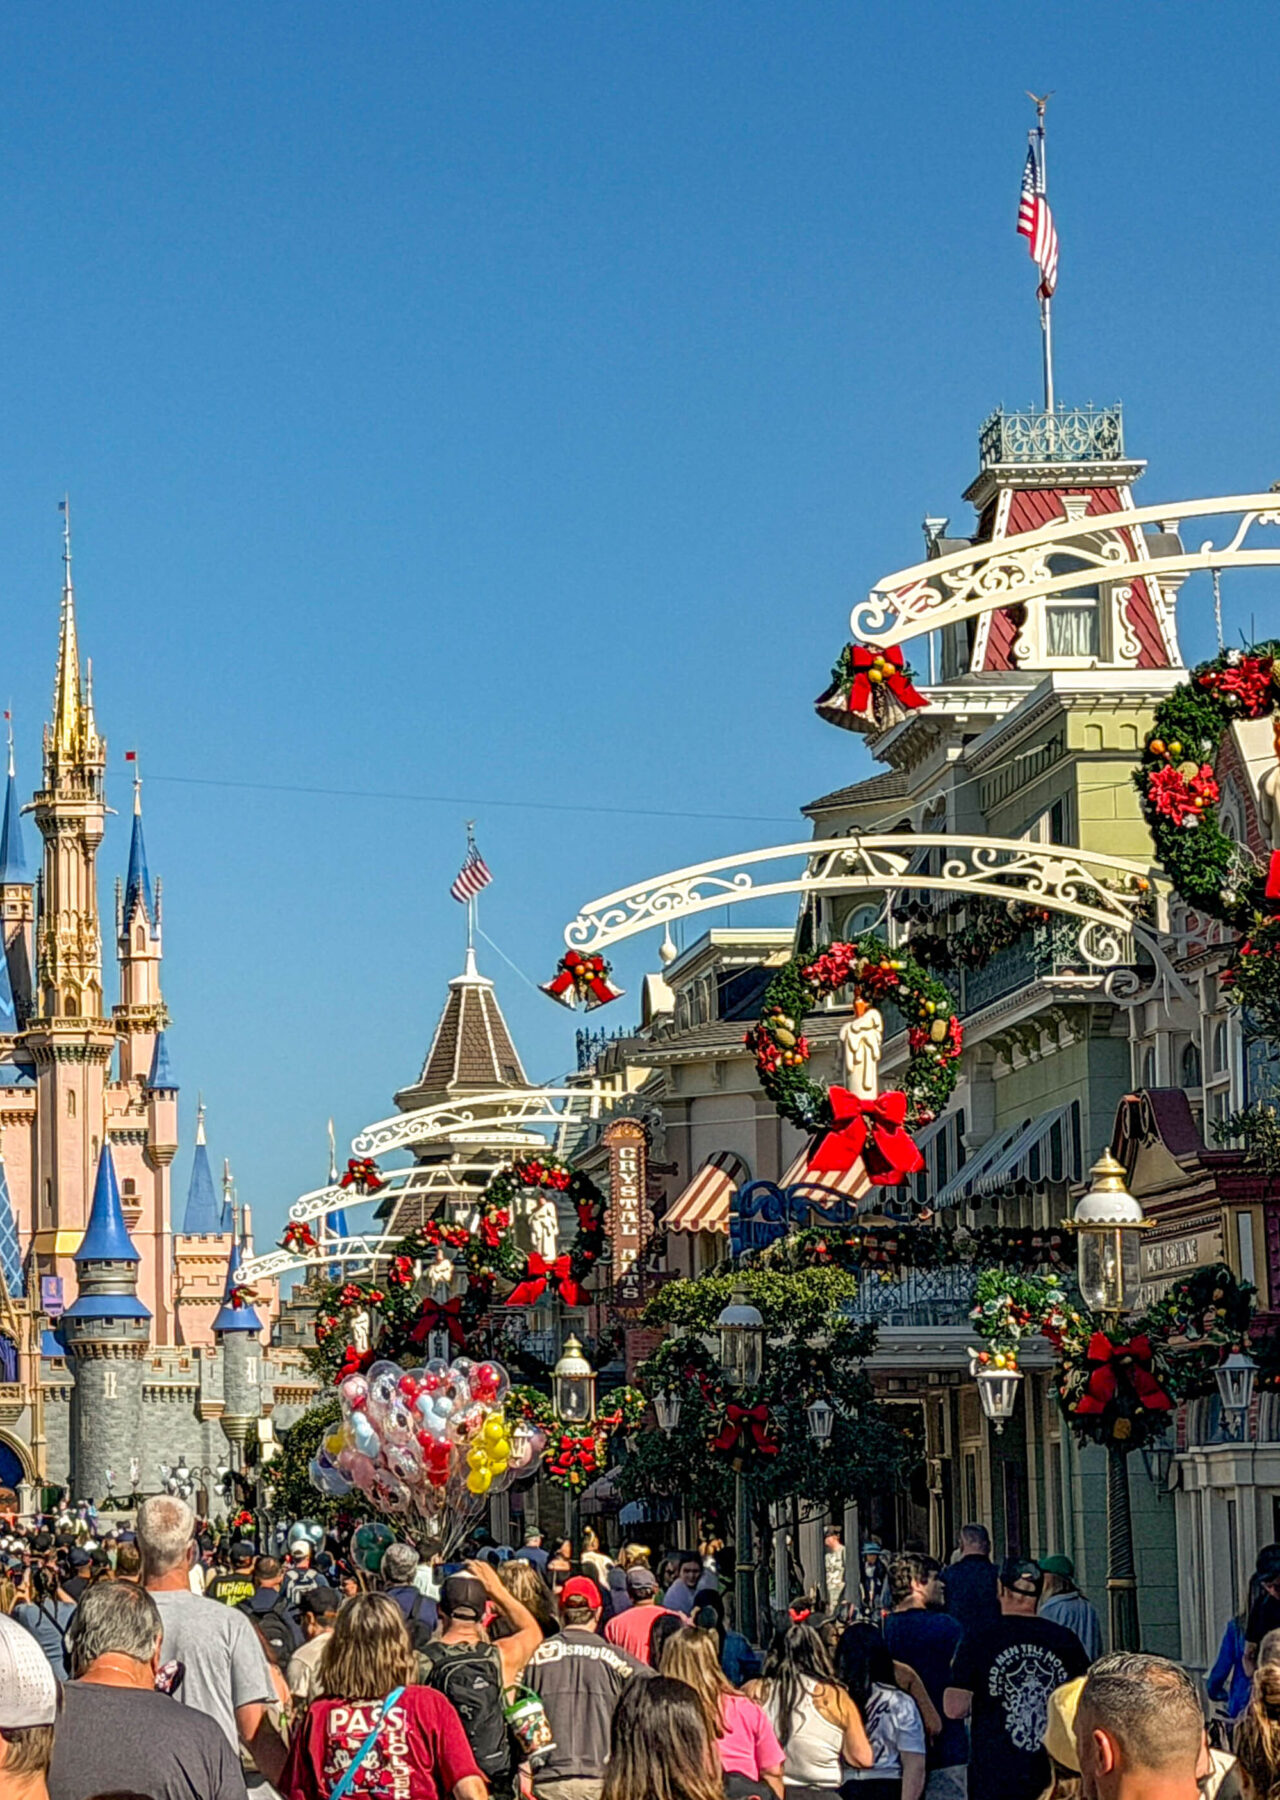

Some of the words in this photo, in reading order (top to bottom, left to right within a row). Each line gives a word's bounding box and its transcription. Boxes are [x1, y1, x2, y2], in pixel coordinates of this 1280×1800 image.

[619, 1147, 637, 1236] CRYSTAL
[621, 1249, 639, 1299] ARTS
[988, 1666, 999, 1696] DEAD
[995, 1645, 1019, 1666] MEN
[1020, 1644, 1044, 1656] TELL
[1043, 1651, 1062, 1668] NO
[330, 1707, 404, 1734] PASS
[388, 1732, 411, 1800] HOLDER
